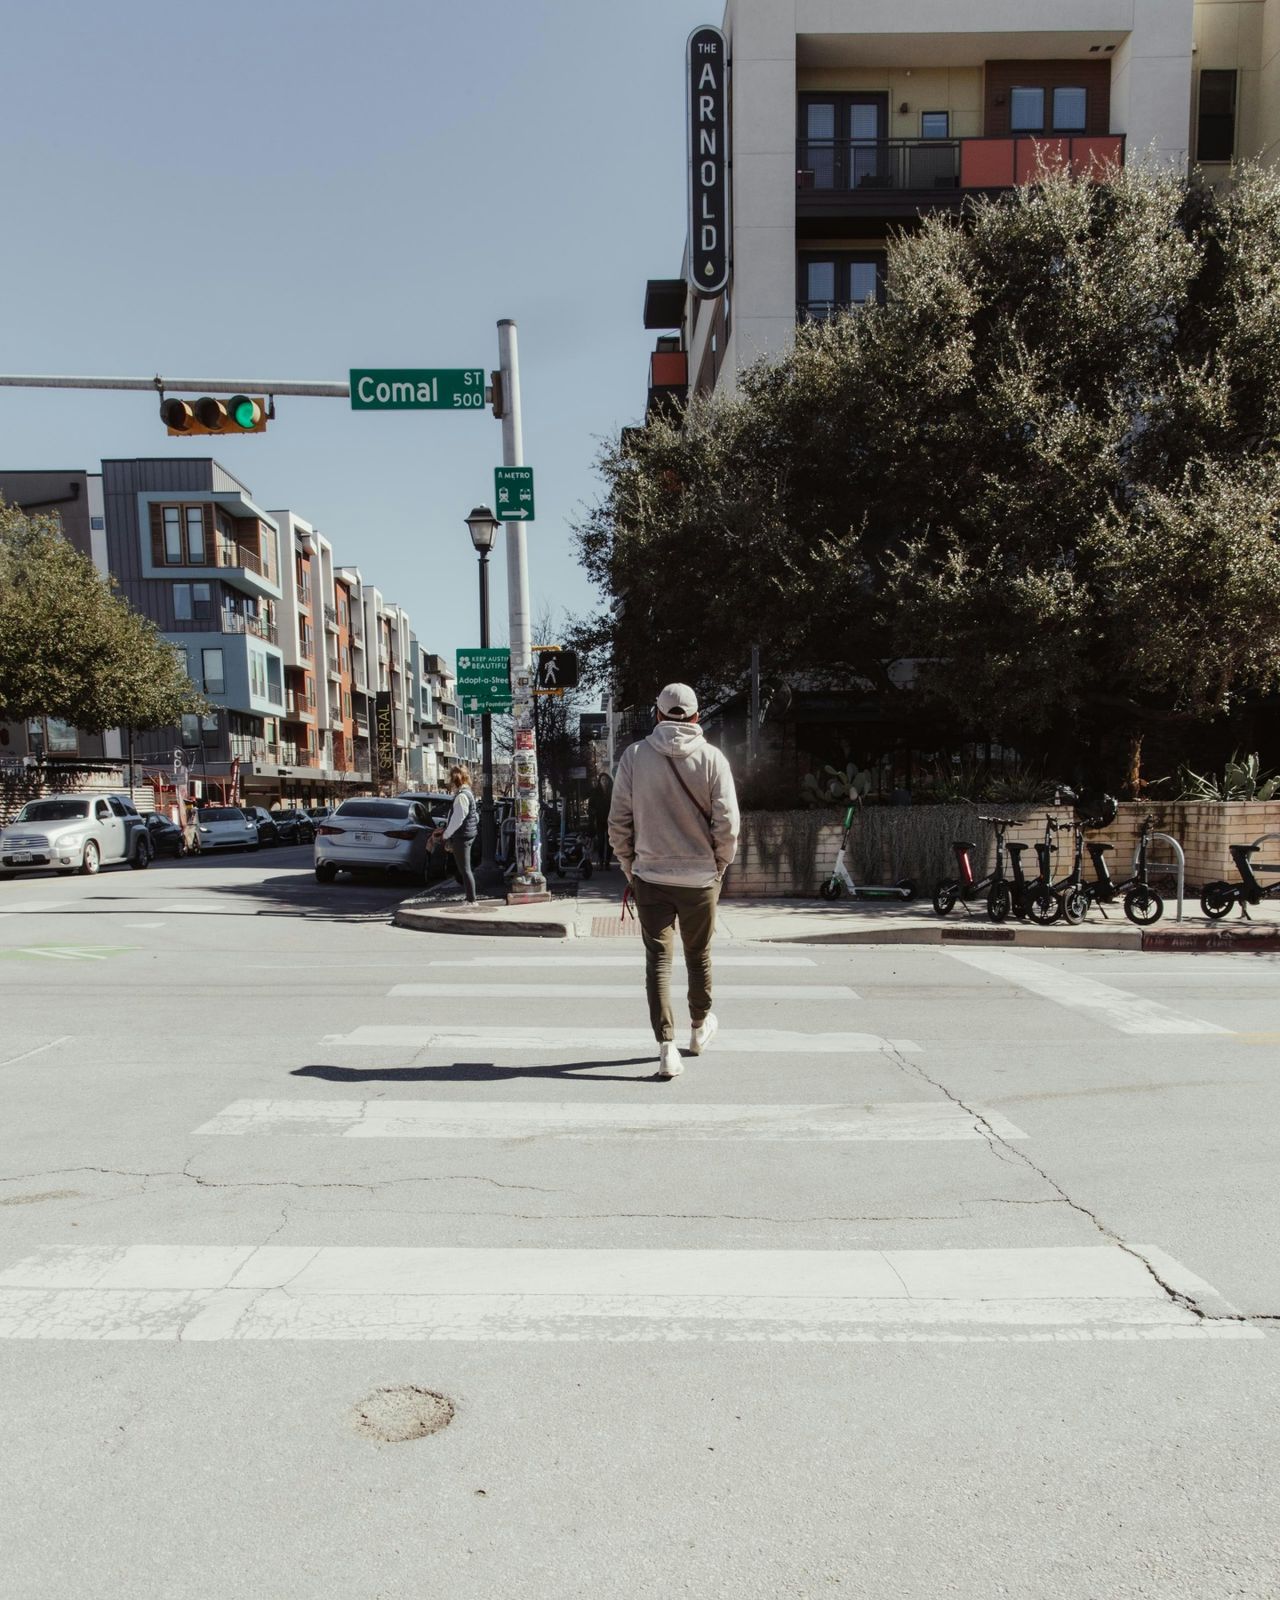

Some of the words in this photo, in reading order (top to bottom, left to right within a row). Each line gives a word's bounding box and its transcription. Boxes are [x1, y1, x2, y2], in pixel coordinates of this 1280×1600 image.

[698, 43, 717, 54] THE
[698, 62, 717, 251] ARNOLD
[464, 372, 482, 386] ST
[358, 376, 438, 403] Comal
[453, 393, 483, 407] 500
[504, 471, 531, 479] METRO
[459, 676, 509, 685] Adopt-a-Stree
